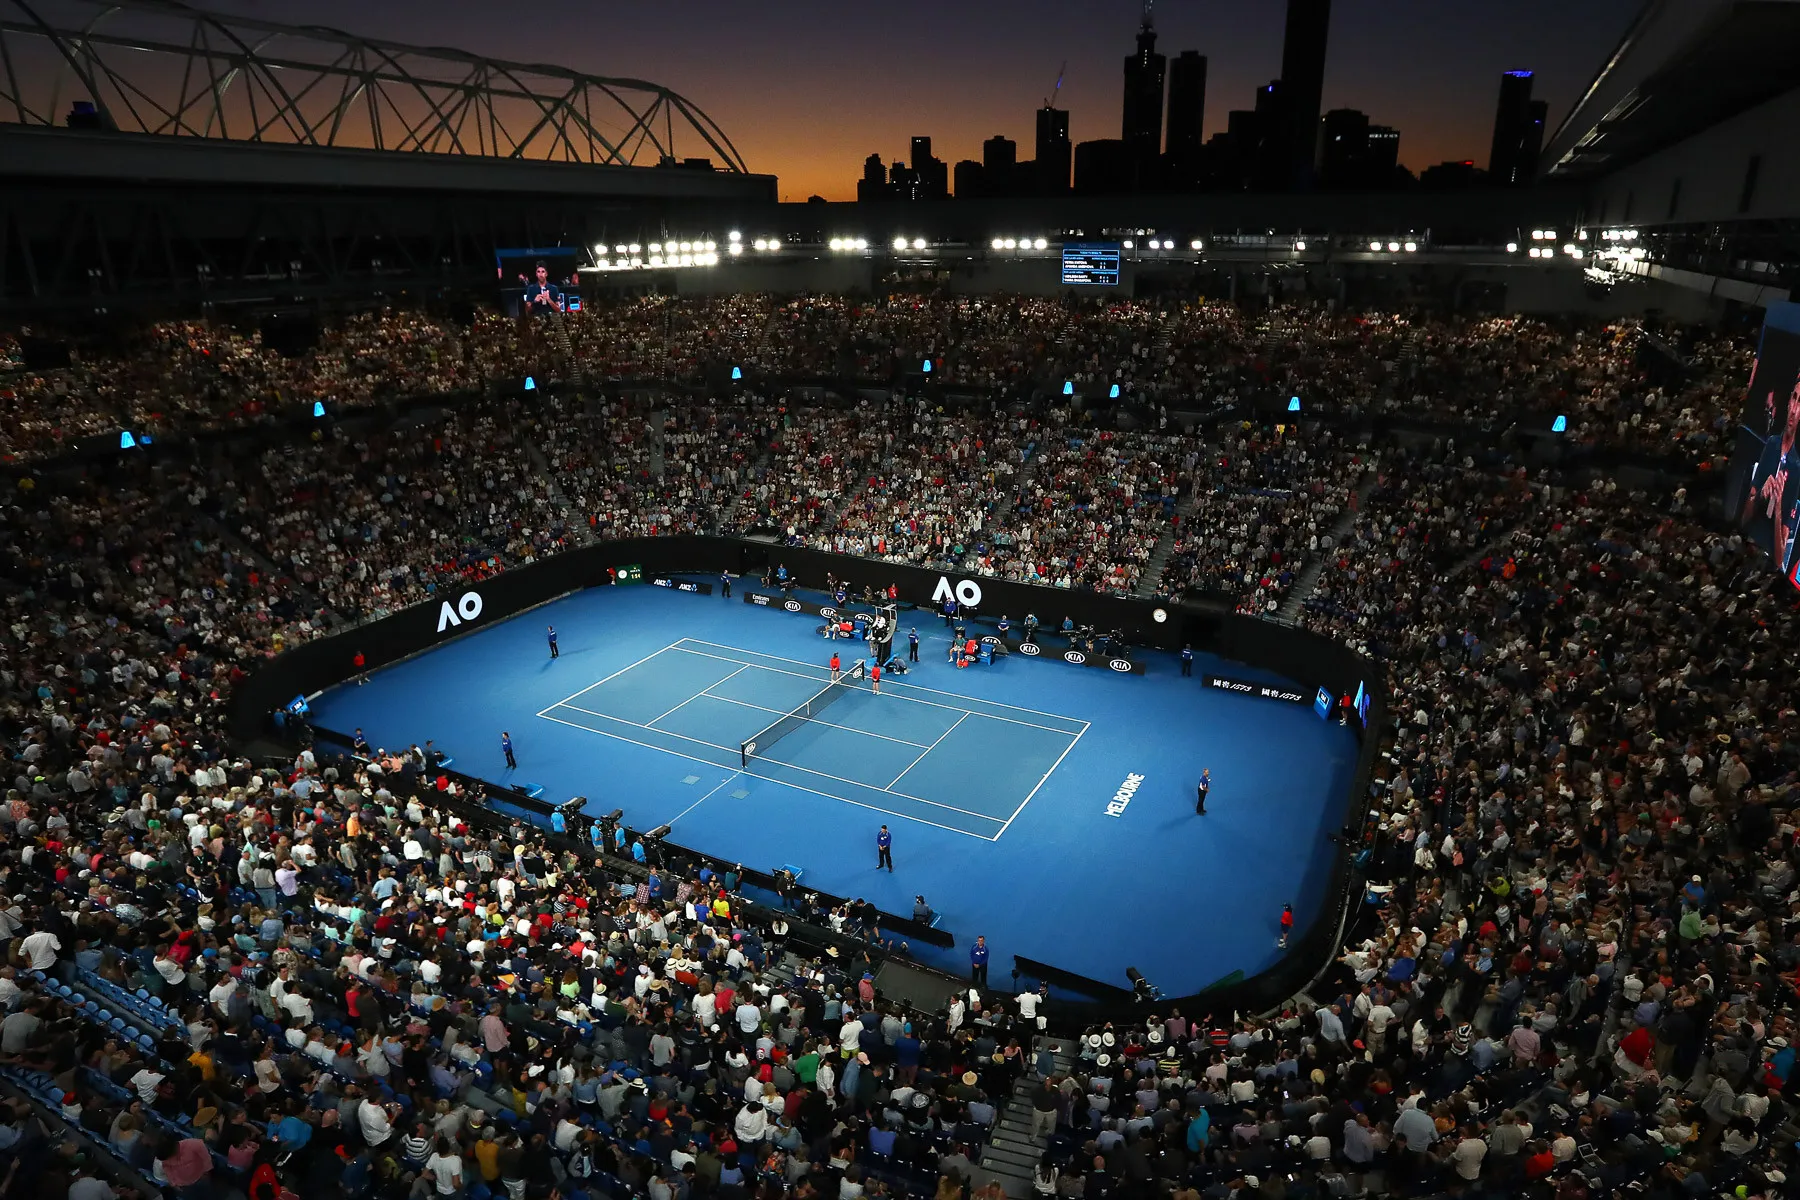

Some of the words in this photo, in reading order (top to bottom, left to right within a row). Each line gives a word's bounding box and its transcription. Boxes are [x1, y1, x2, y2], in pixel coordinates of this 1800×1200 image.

[653, 578, 667, 587] ANZ
[678, 583, 692, 591] ANZ
[932, 576, 982, 607] AO
[437, 591, 483, 632] AO
[1104, 772, 1146, 818] MELBOURNE
